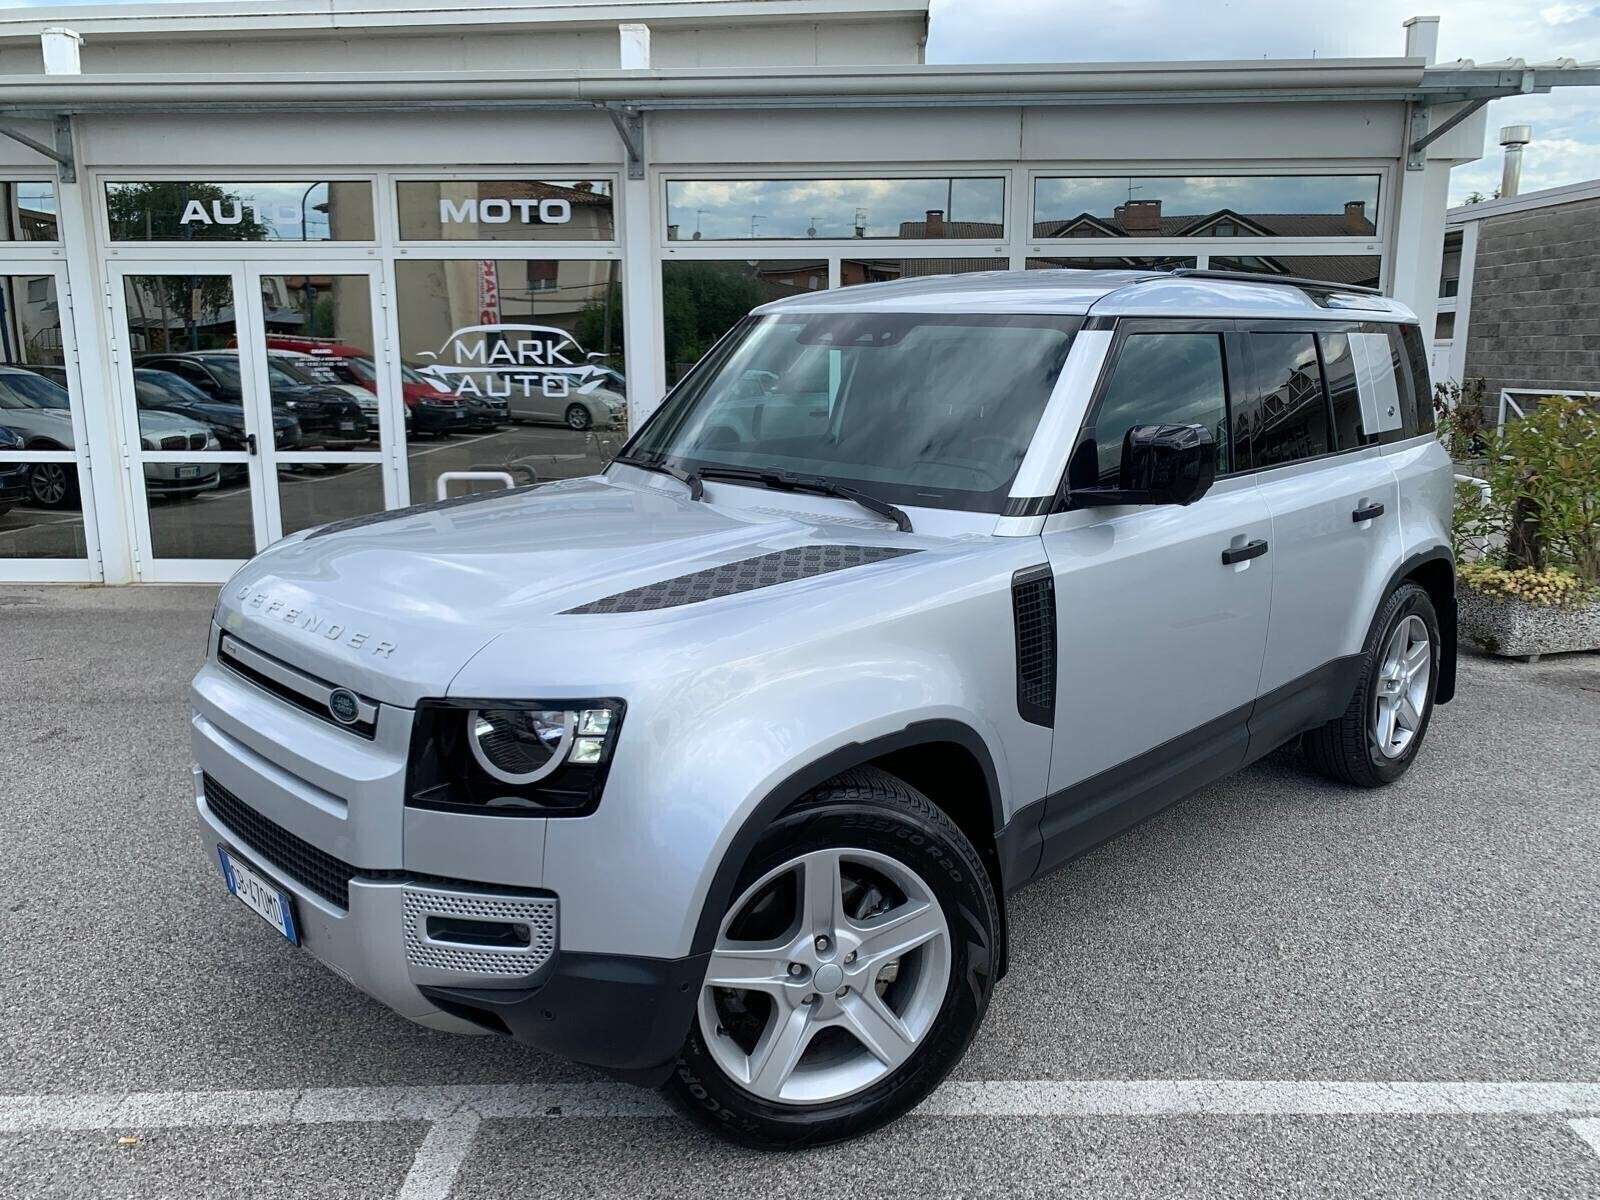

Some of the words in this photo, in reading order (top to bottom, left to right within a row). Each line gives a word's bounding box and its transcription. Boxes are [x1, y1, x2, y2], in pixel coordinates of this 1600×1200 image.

[180, 199, 303, 225] AUTO
[440, 198, 572, 224] MOTO
[454, 339, 574, 366] MARK
[454, 374, 569, 398] AUTO
[236, 587, 399, 660] DEFENDER
